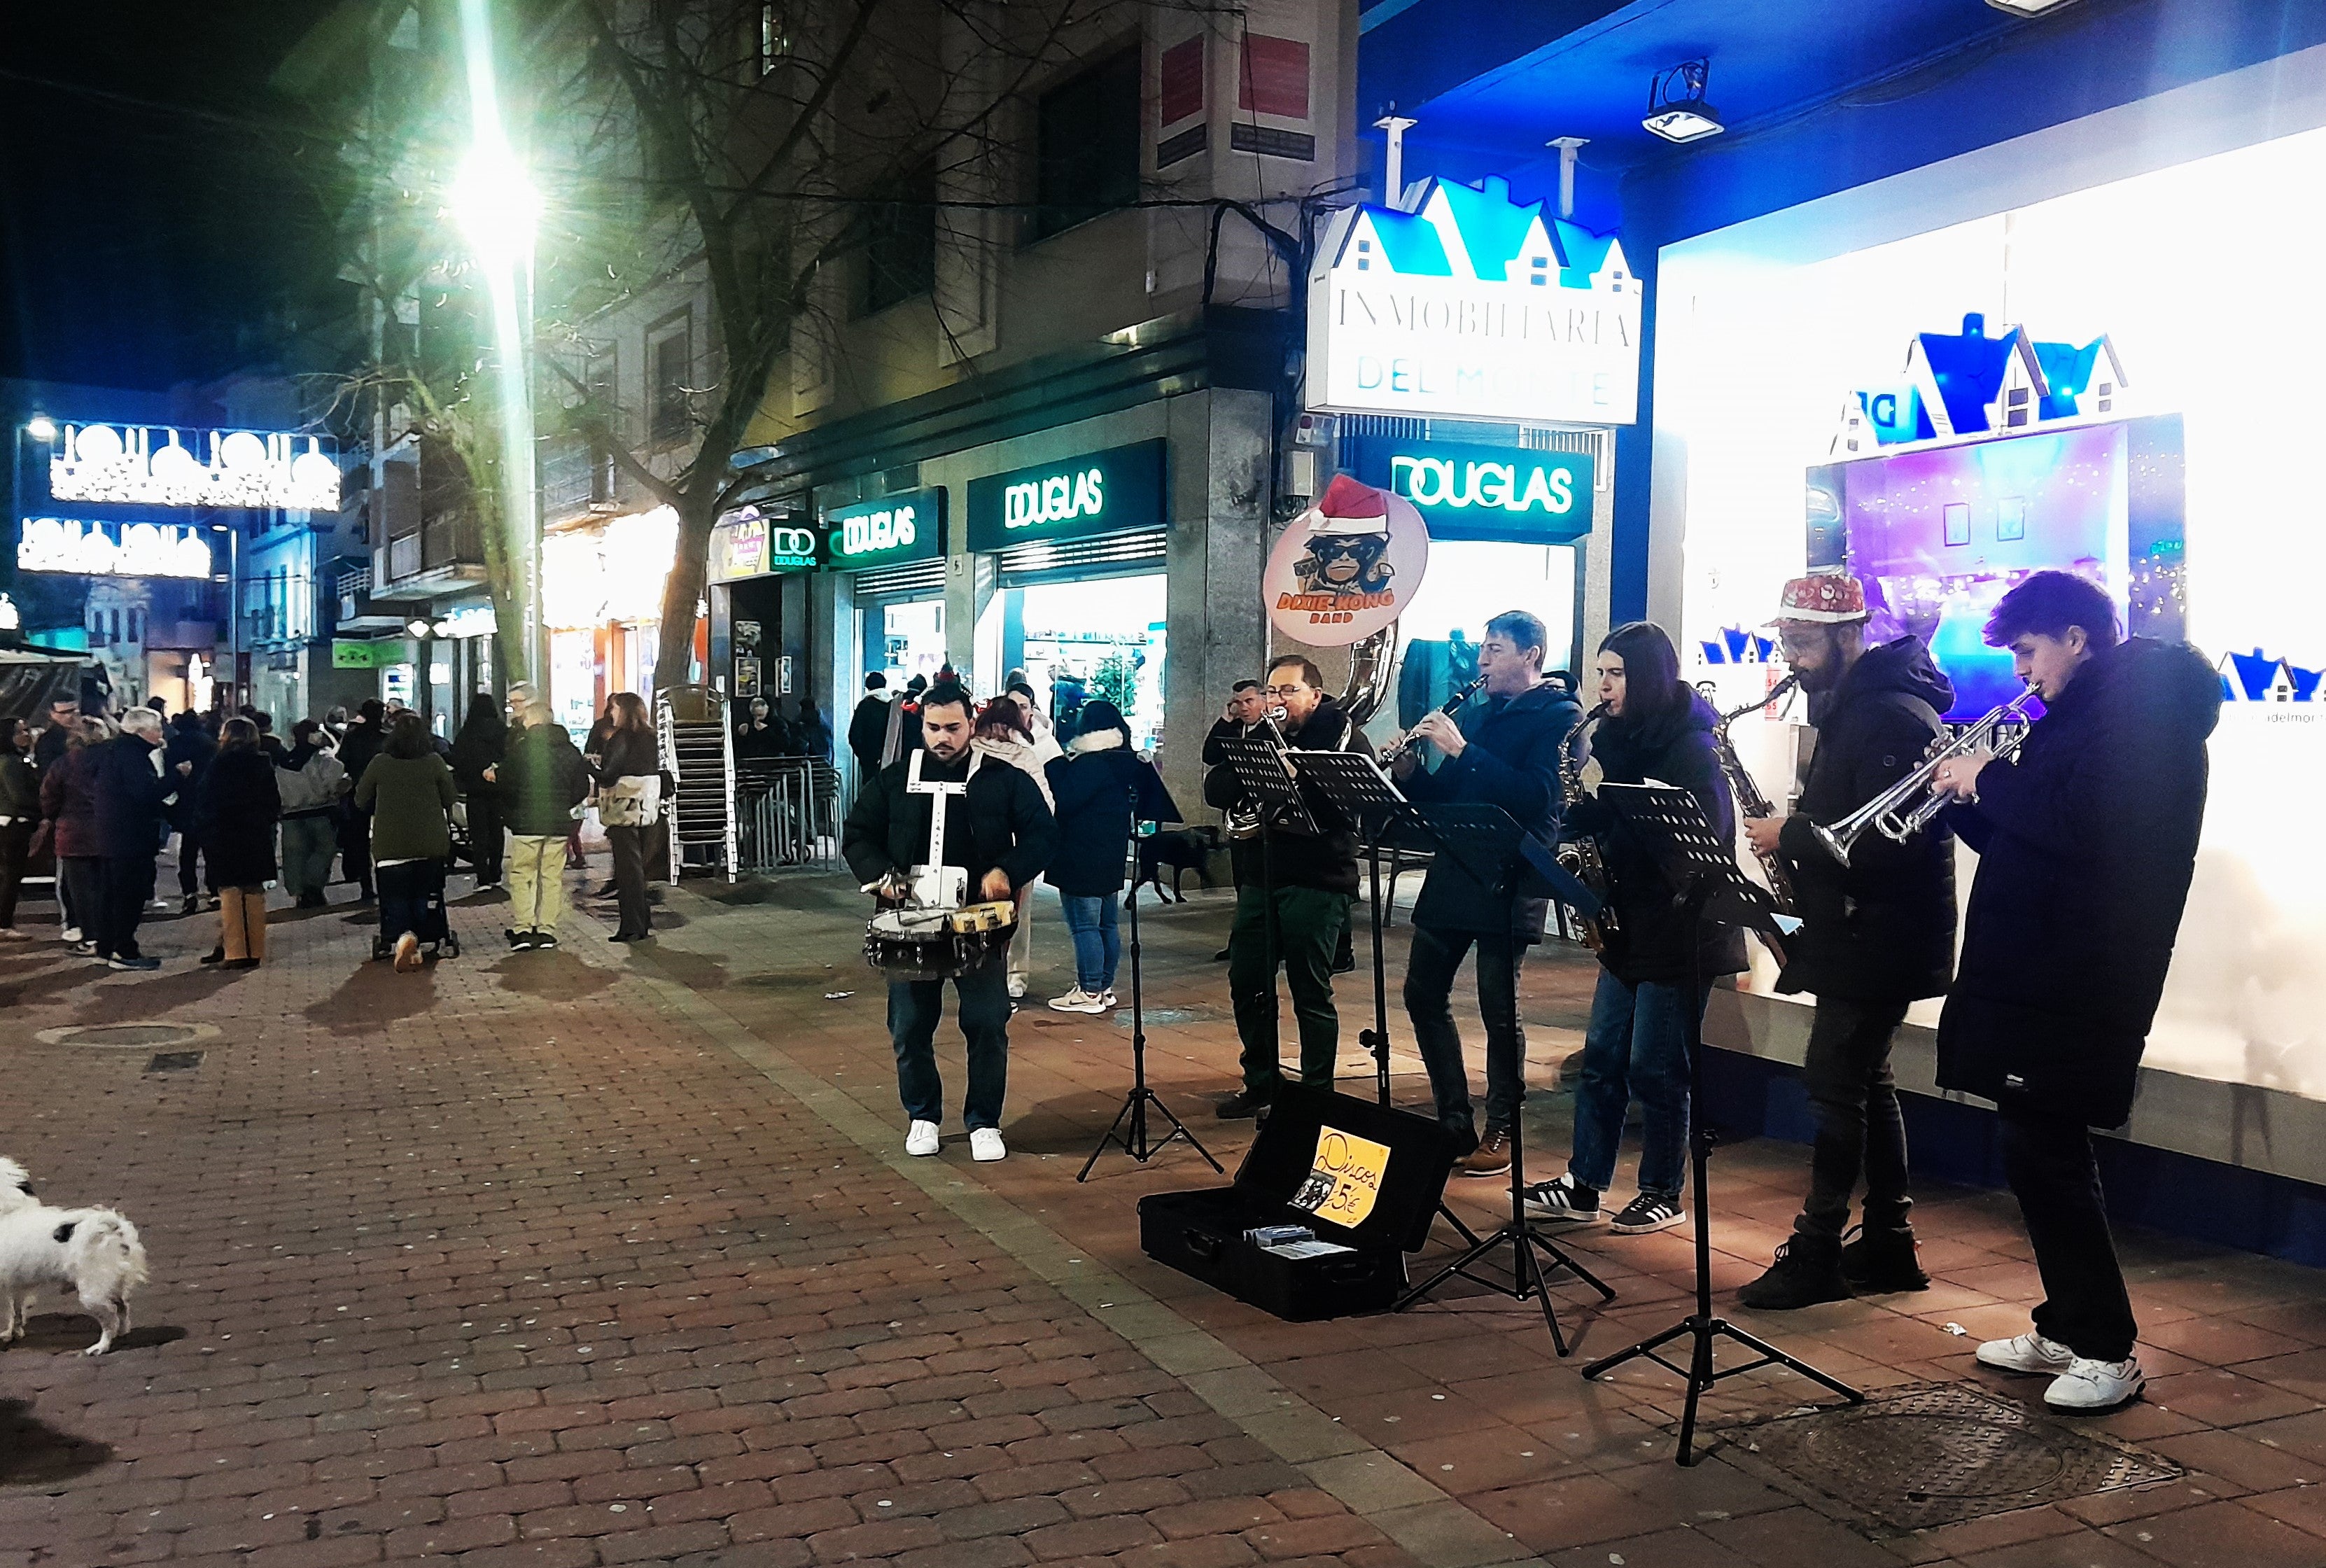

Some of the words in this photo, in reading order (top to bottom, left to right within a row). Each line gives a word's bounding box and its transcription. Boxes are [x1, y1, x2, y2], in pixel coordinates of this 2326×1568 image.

[1357, 356, 1437, 394] DEL
[1004, 468, 1104, 529] DOUGLAS
[1391, 456, 1573, 514] DOUGLAS
[843, 505, 916, 556] DOUGLAS
[774, 555, 817, 566] DOUGLAS
[1310, 612, 1354, 624] BAND
[1315, 1133, 1378, 1191] Discos
